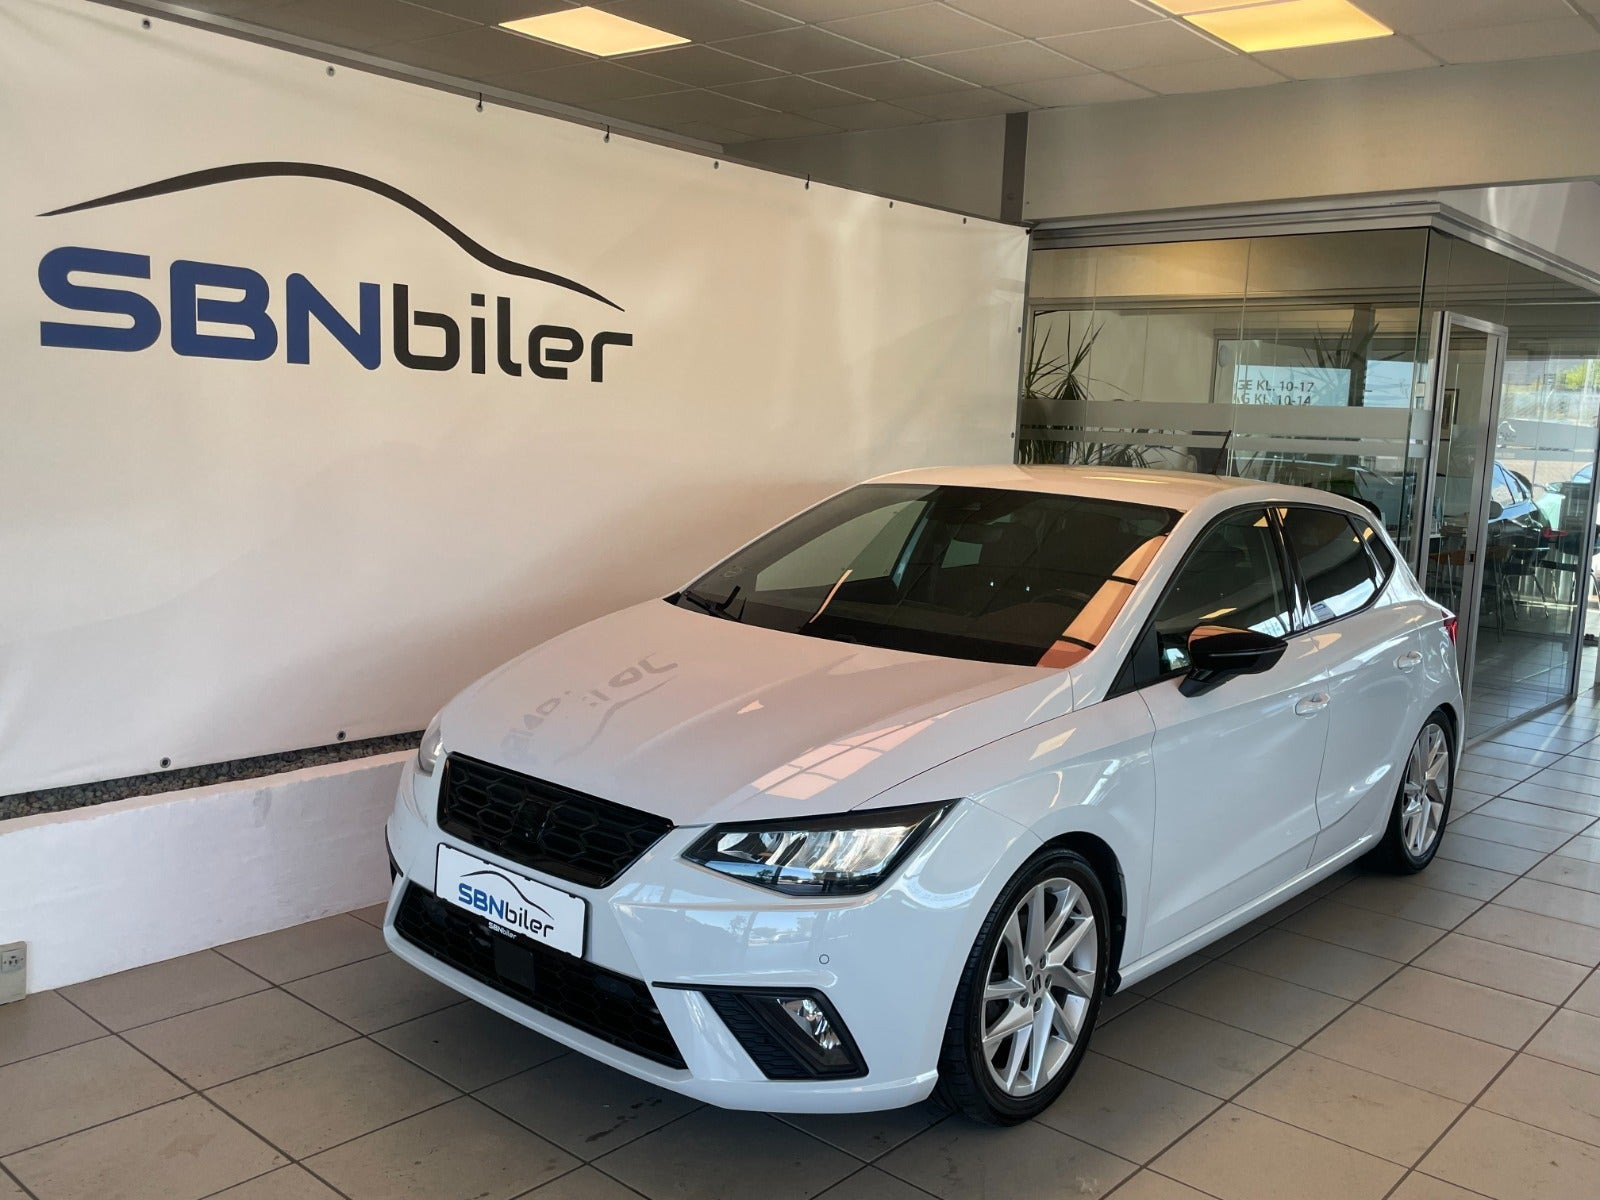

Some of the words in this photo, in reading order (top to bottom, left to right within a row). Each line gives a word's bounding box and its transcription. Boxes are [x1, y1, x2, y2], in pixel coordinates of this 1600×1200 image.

[38, 246, 633, 382] SBNbiler
[1277, 395, 1311, 406] 10-14
[1280, 381, 1314, 392] 10-17
[458, 882, 554, 937] SBNbiler
